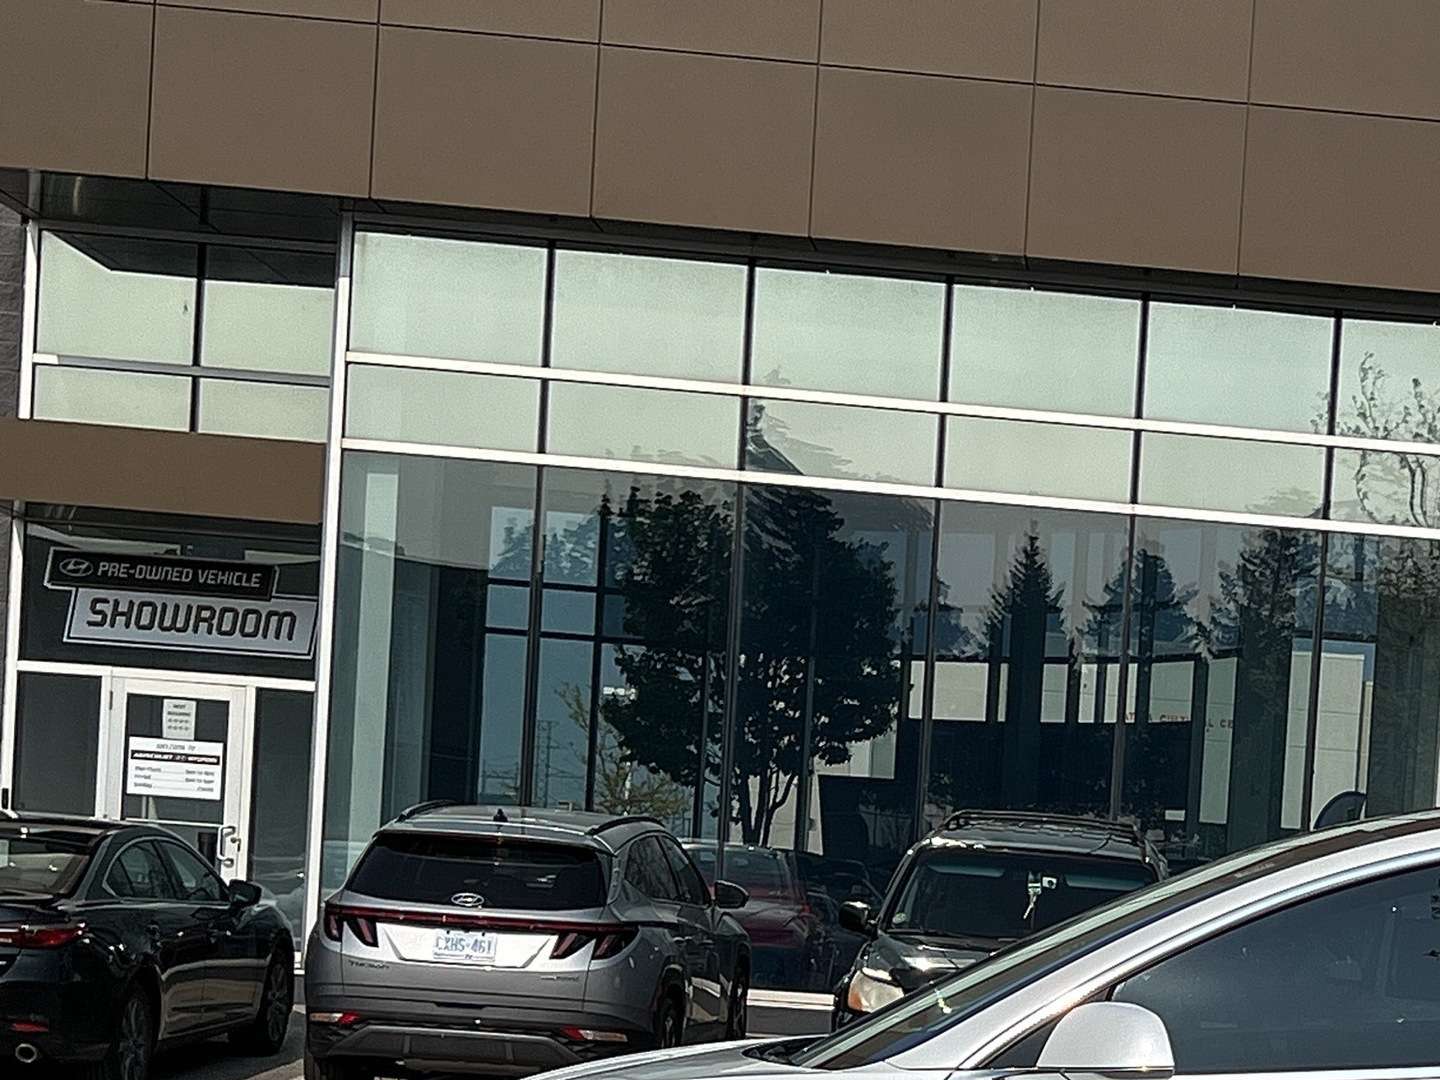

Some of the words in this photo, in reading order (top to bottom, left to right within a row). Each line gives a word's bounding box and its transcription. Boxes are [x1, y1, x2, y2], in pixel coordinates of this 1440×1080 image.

[97, 561, 193, 583] PRE-OWNED
[198, 569, 262, 589] VEHICLE
[86, 597, 297, 641] SHOWROOM
